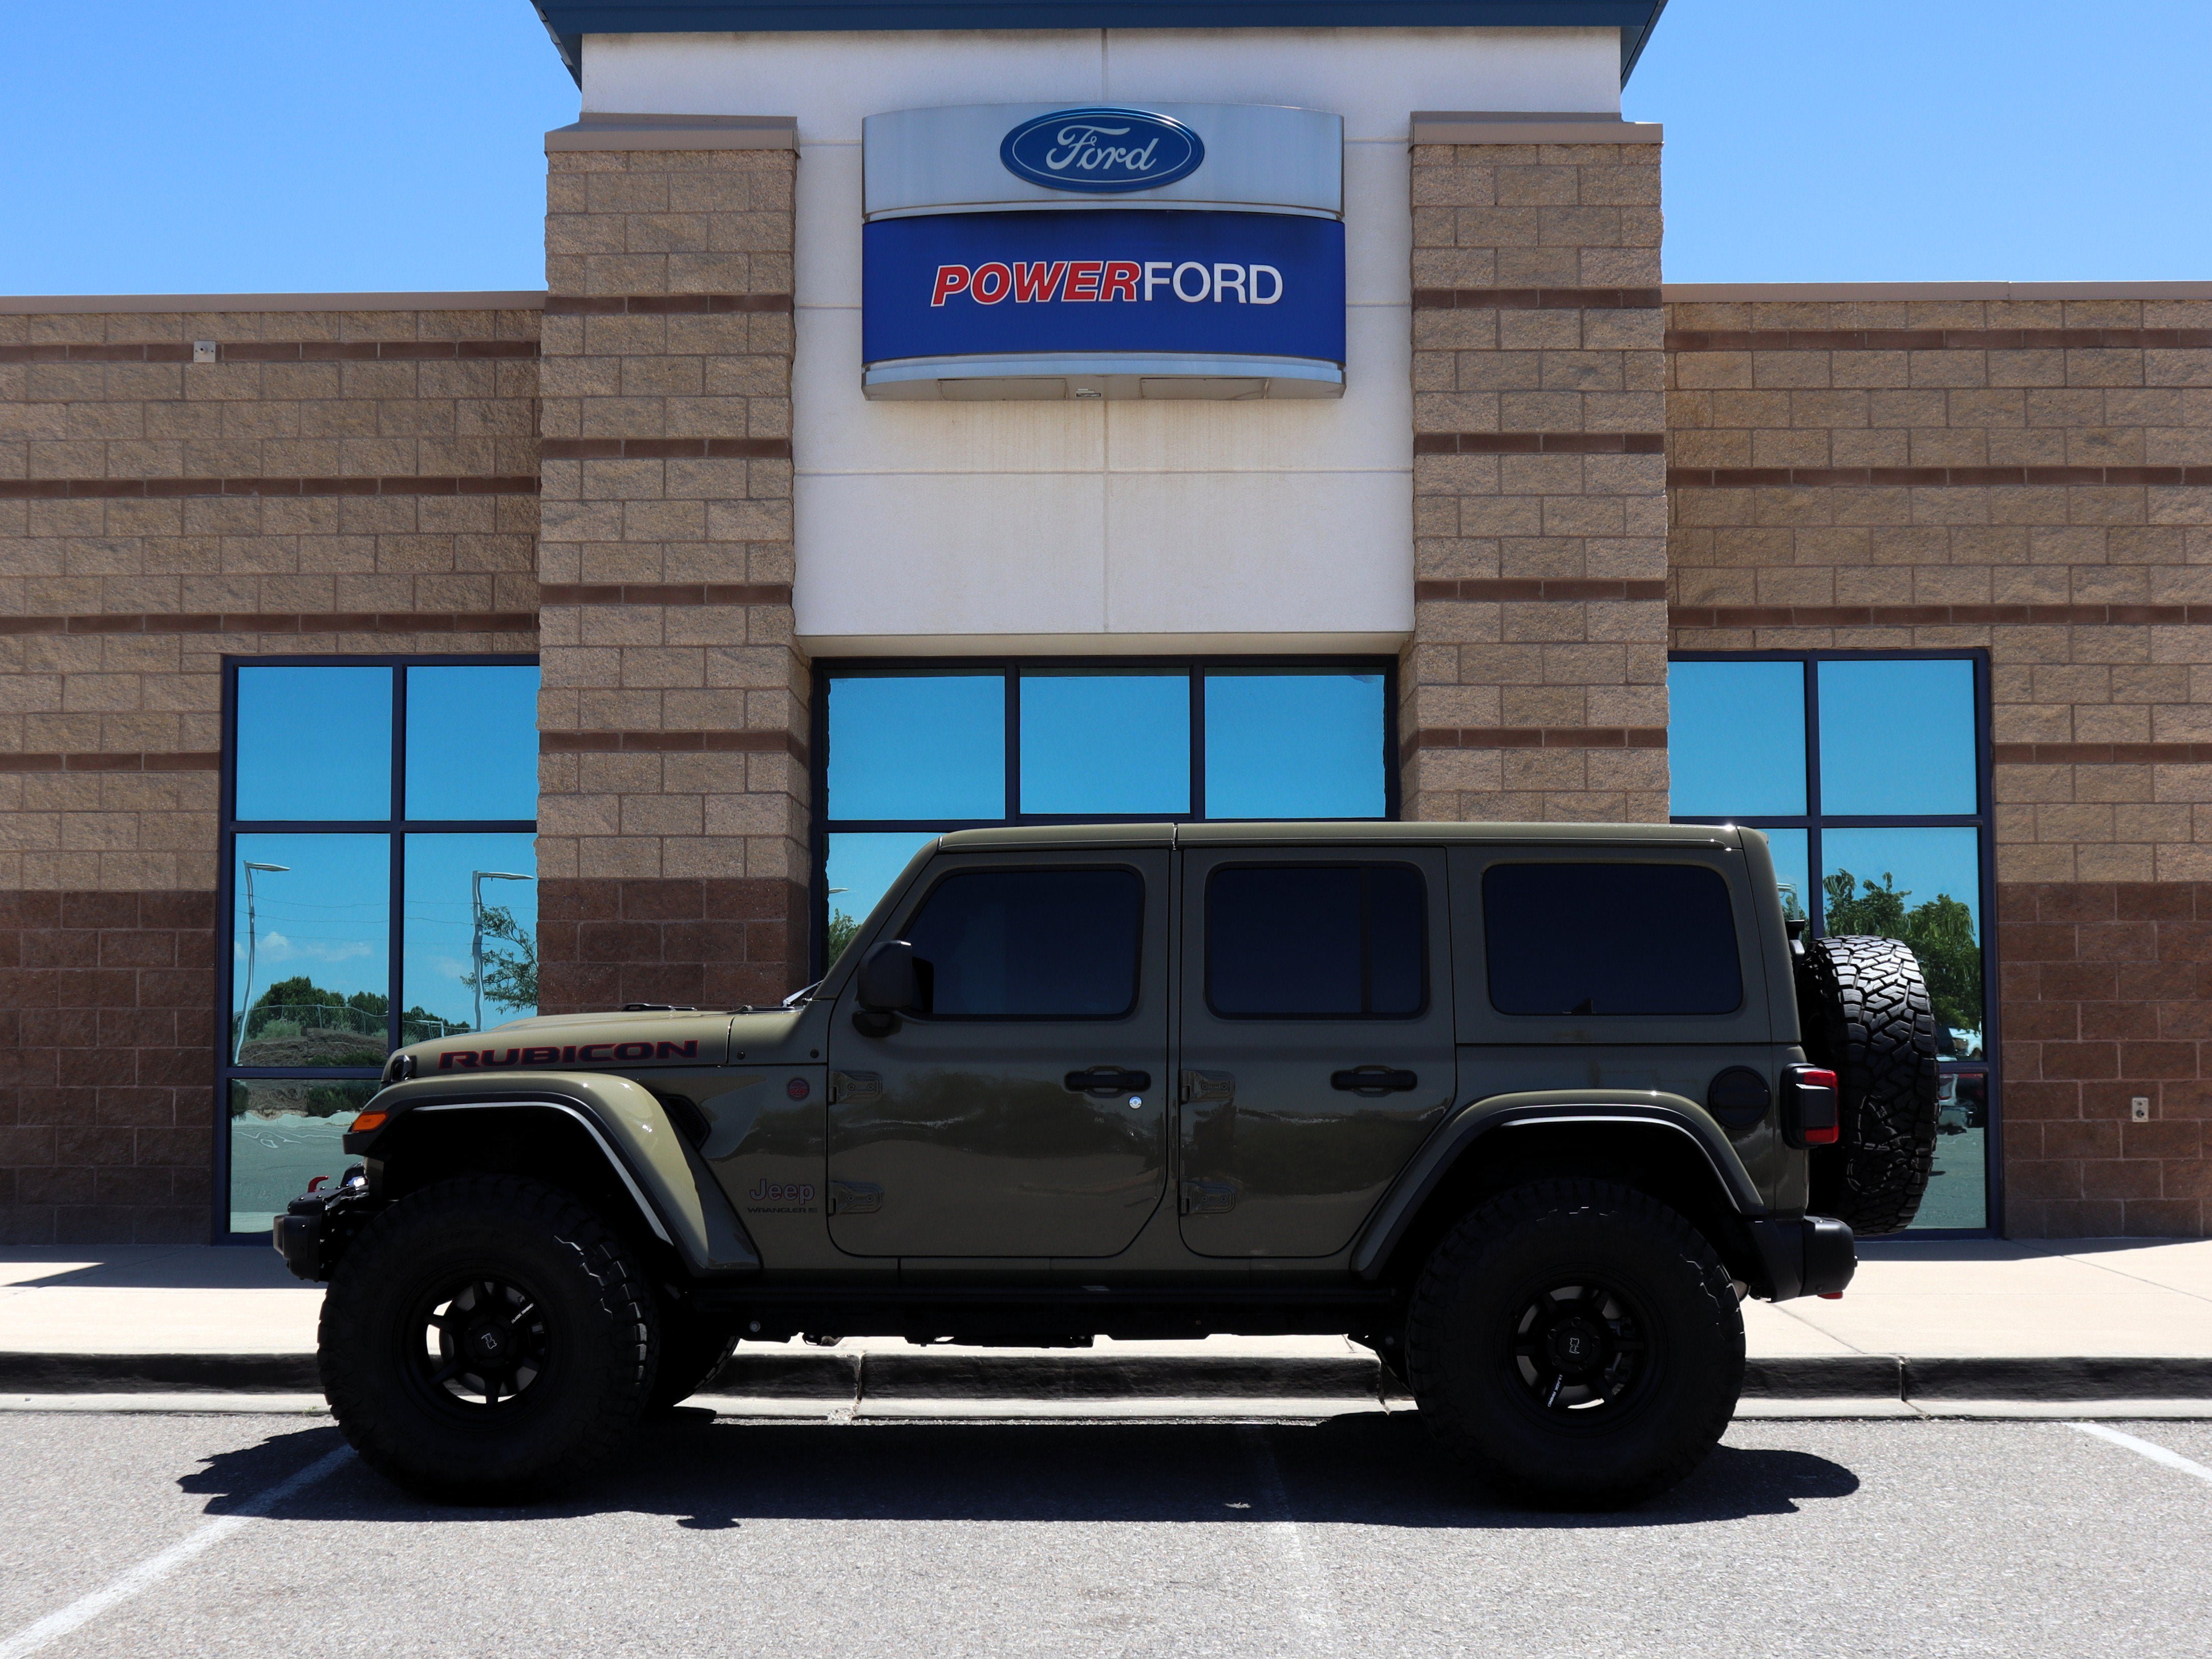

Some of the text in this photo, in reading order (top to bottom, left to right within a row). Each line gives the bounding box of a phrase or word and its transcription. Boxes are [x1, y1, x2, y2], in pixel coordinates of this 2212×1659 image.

[1046, 125, 1159, 171] Ford
[439, 1040, 698, 1070] RUBICON
[749, 1179, 815, 1205] Jeep
